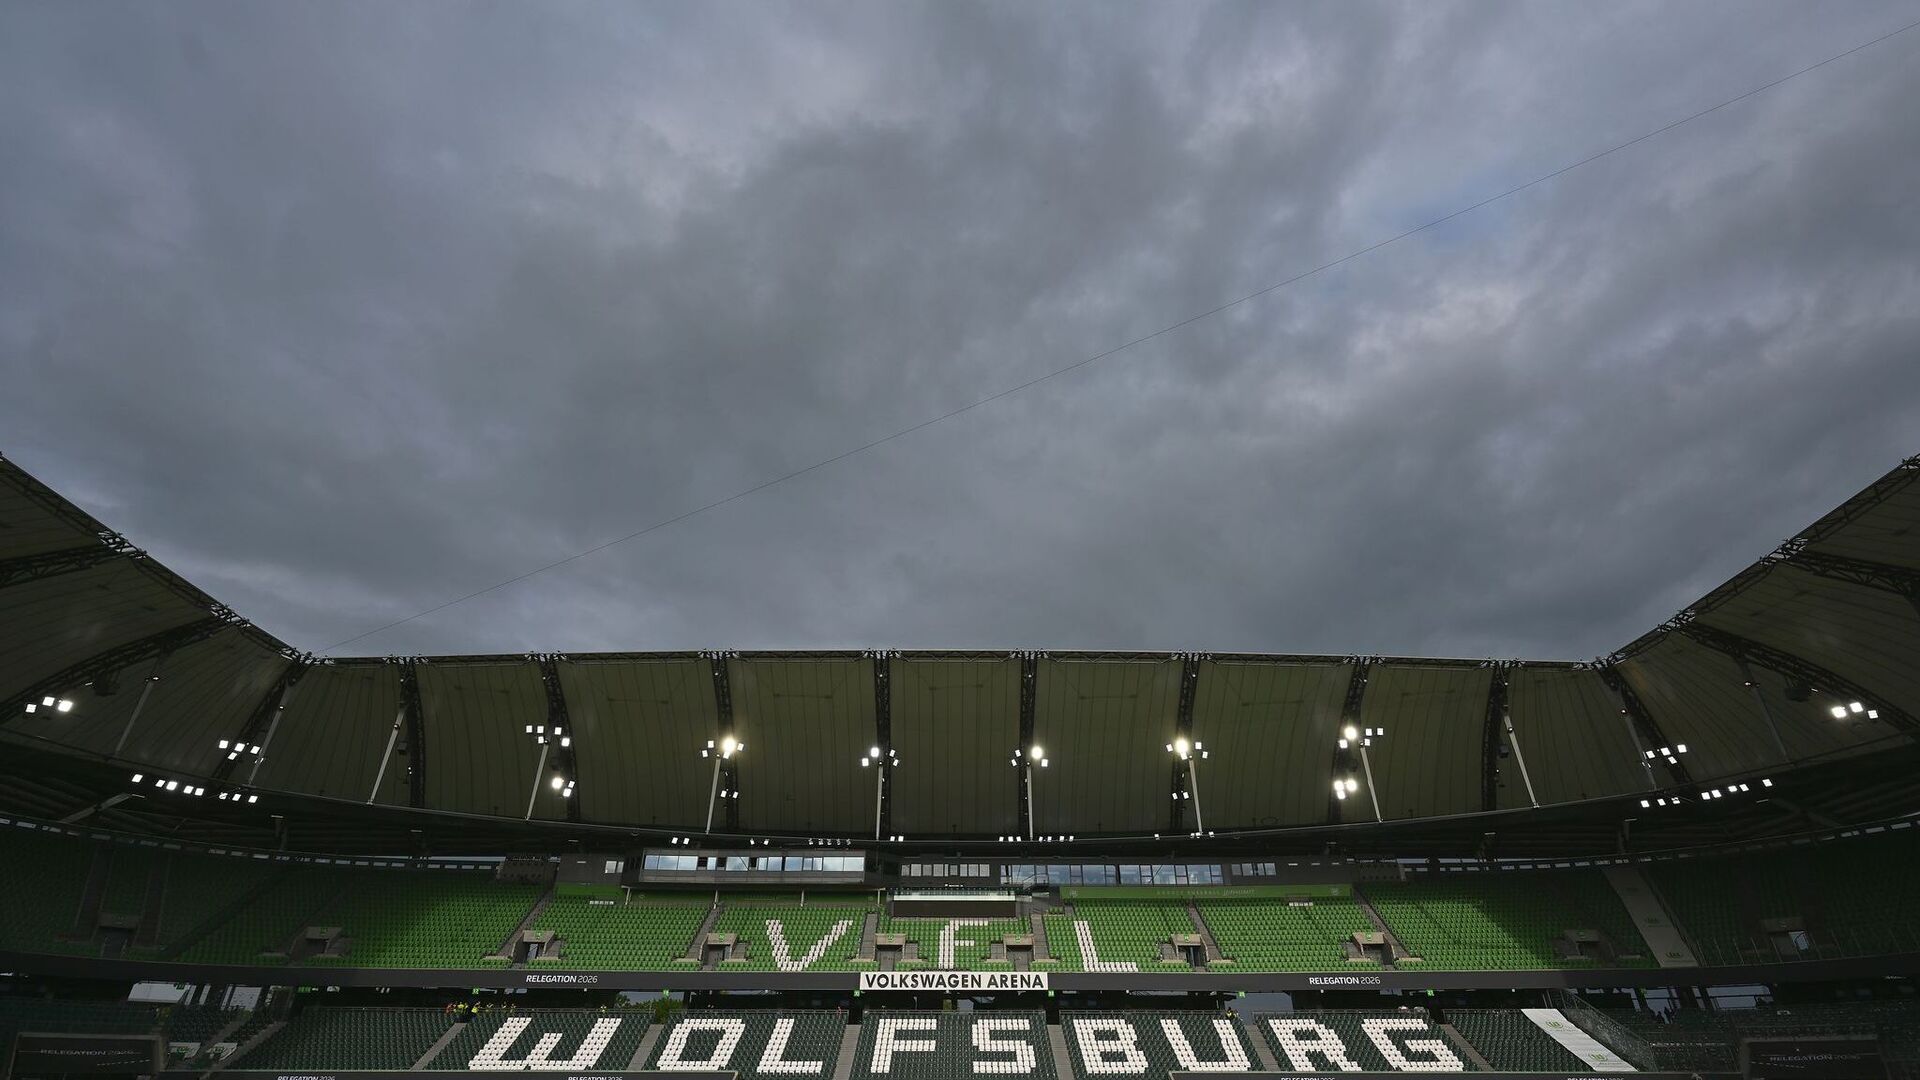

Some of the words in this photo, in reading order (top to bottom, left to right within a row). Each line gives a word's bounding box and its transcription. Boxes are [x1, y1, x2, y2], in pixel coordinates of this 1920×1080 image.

[525, 975, 577, 984] RELEGATION
[577, 975, 598, 984] 2026
[865, 974, 982, 988] VOLKSWAGEN
[987, 974, 1044, 988] ARENA
[1309, 977, 1359, 986] RELEGATION
[1360, 977, 1381, 986] 2026
[468, 1017, 1465, 1073] WOLFSBURG
[1769, 1054, 1833, 1063] RELEGATION
